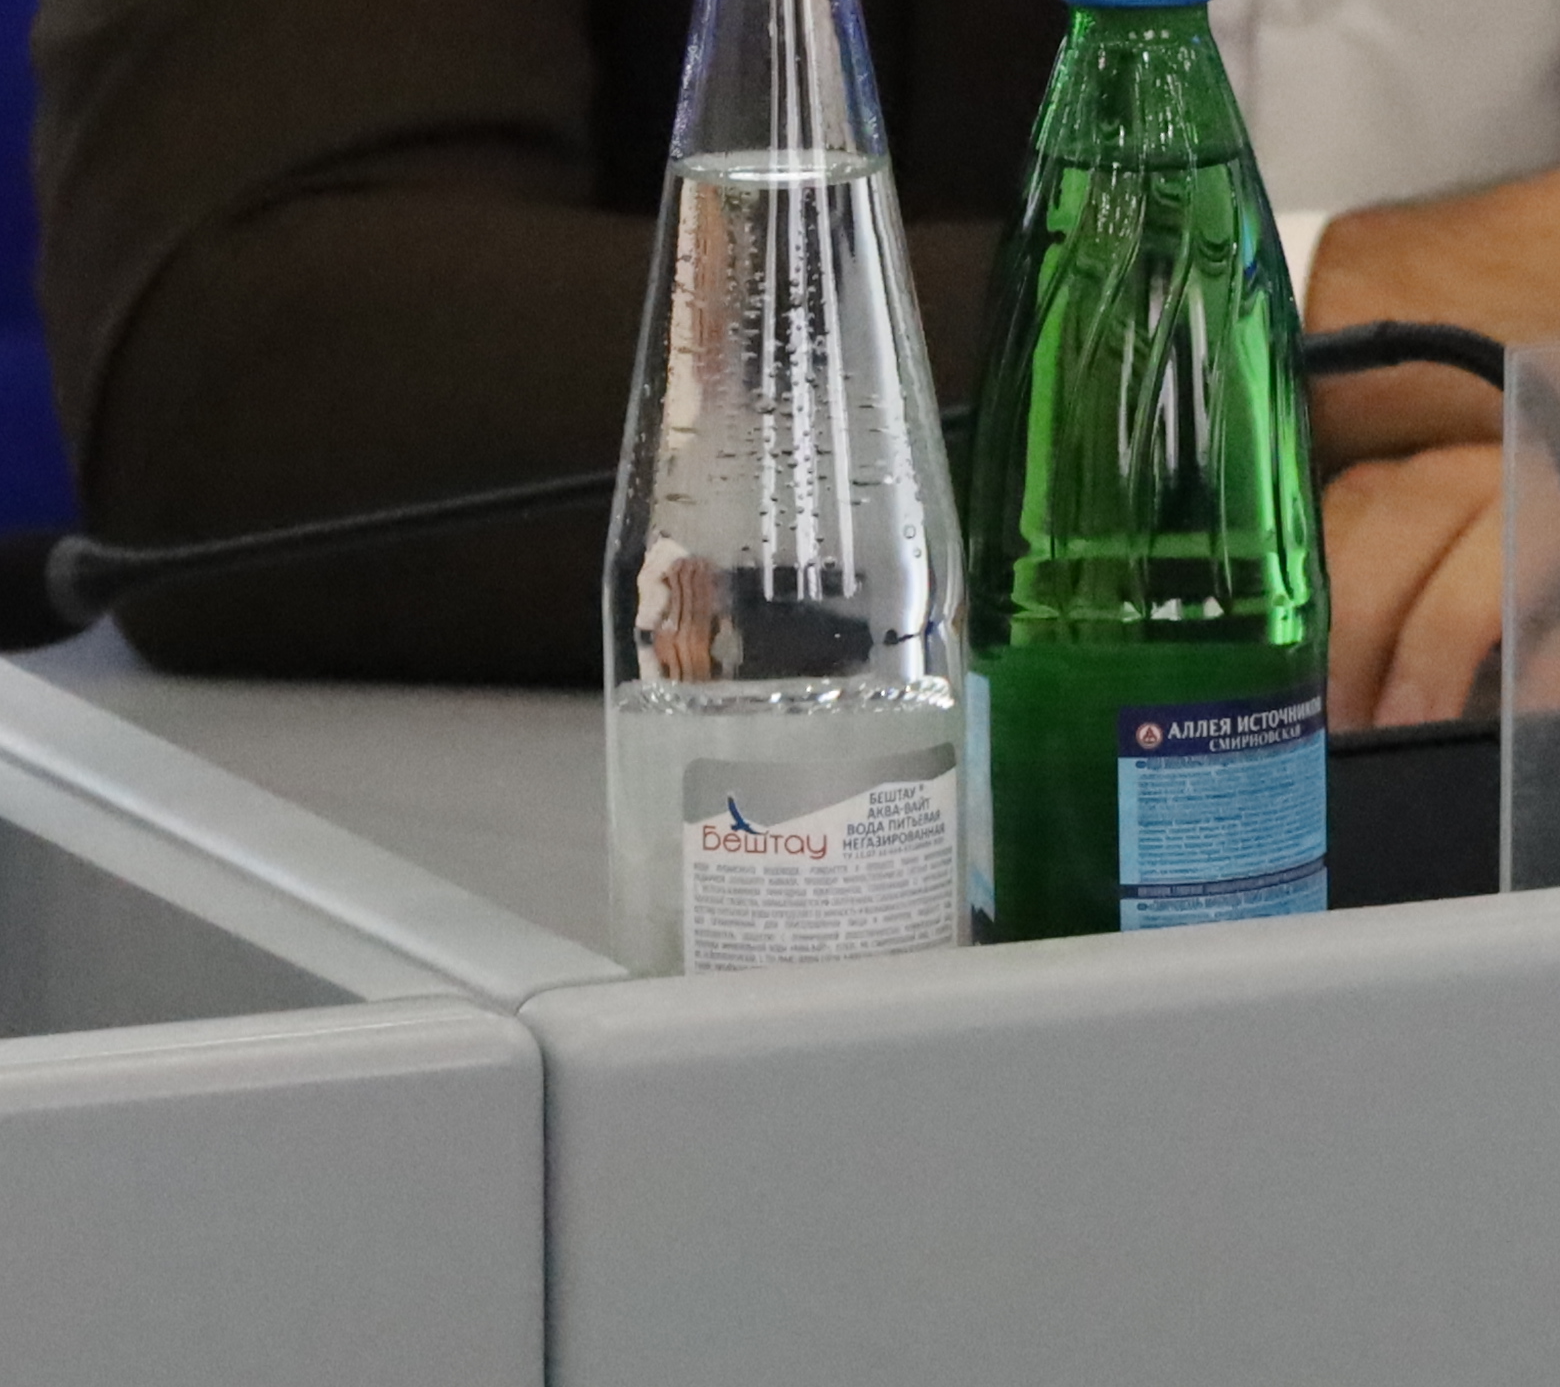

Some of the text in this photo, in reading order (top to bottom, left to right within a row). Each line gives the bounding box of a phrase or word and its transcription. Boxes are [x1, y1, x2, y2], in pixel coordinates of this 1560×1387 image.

[1168, 718, 1231, 739] АЛЛЕЯ
[1209, 724, 1301, 752] СМИРНОВСКАЯ
[869, 787, 916, 805] БЕШТАУ
[842, 823, 945, 851] НЕГАЗИРОВАННАЯ
[847, 810, 940, 837] ВОДА ПИТЬЕВАЯ
[702, 825, 828, 860] Бештау
